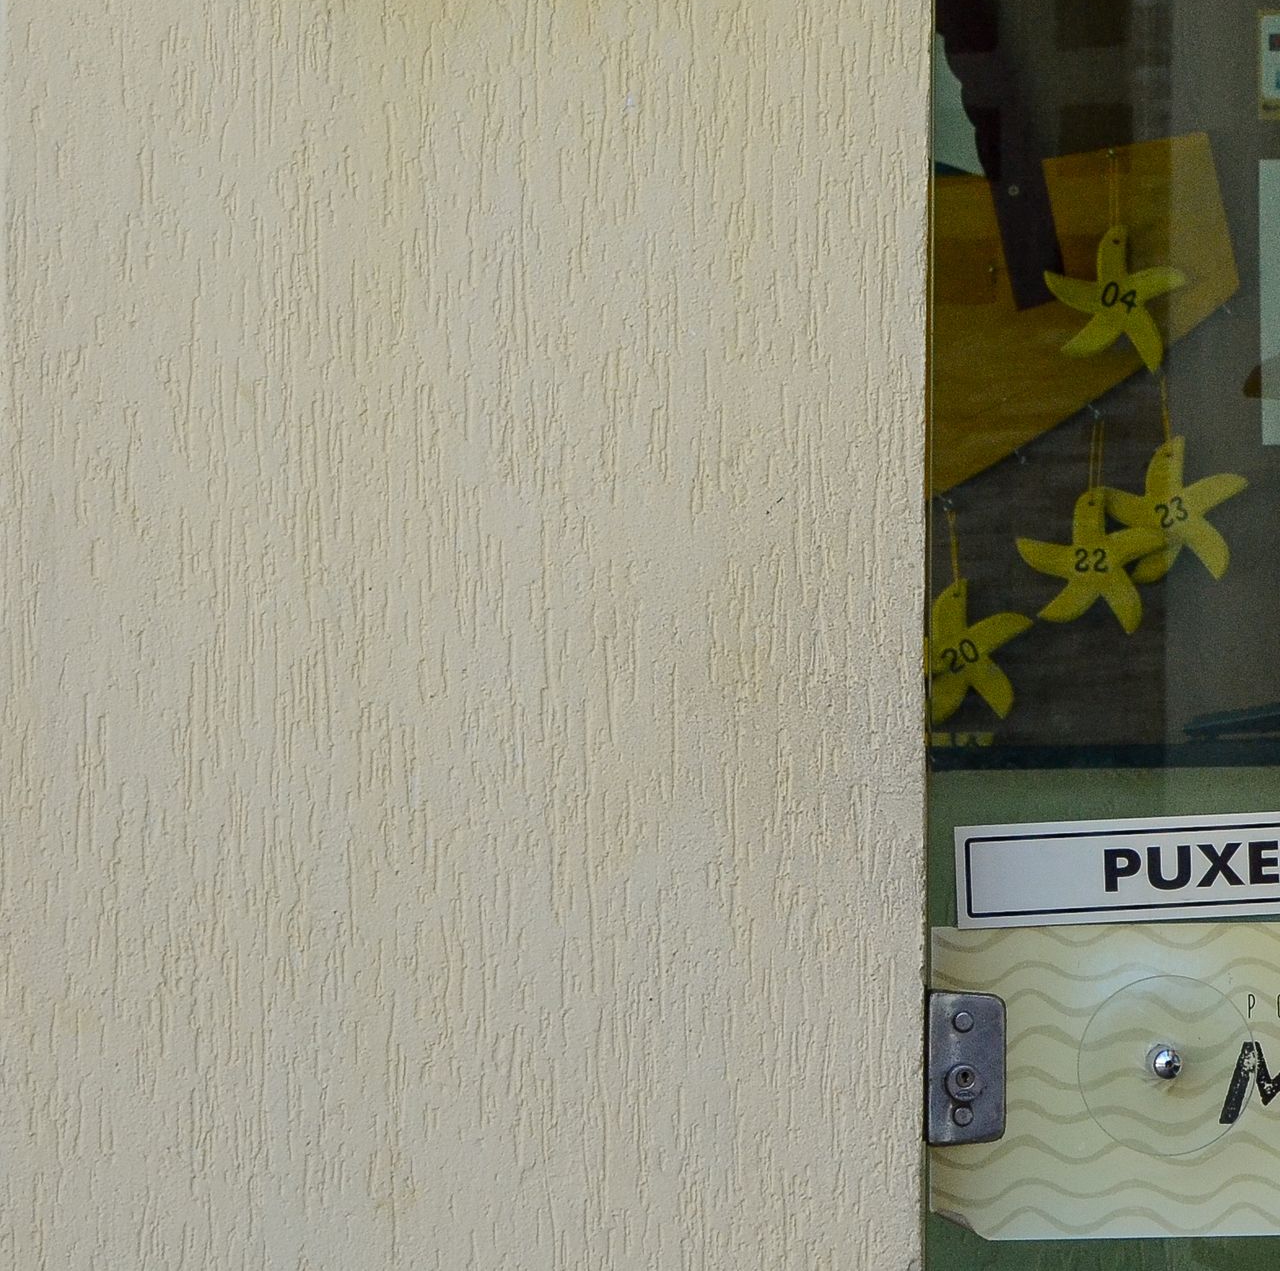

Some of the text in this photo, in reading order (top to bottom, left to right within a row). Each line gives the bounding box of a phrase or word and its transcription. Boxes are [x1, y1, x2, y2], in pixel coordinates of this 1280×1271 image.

[1101, 280, 1138, 314] 04
[1153, 496, 1188, 527] 23
[1074, 548, 1108, 574] 22
[941, 639, 980, 673] 20
[1103, 840, 1280, 893] PUXE
